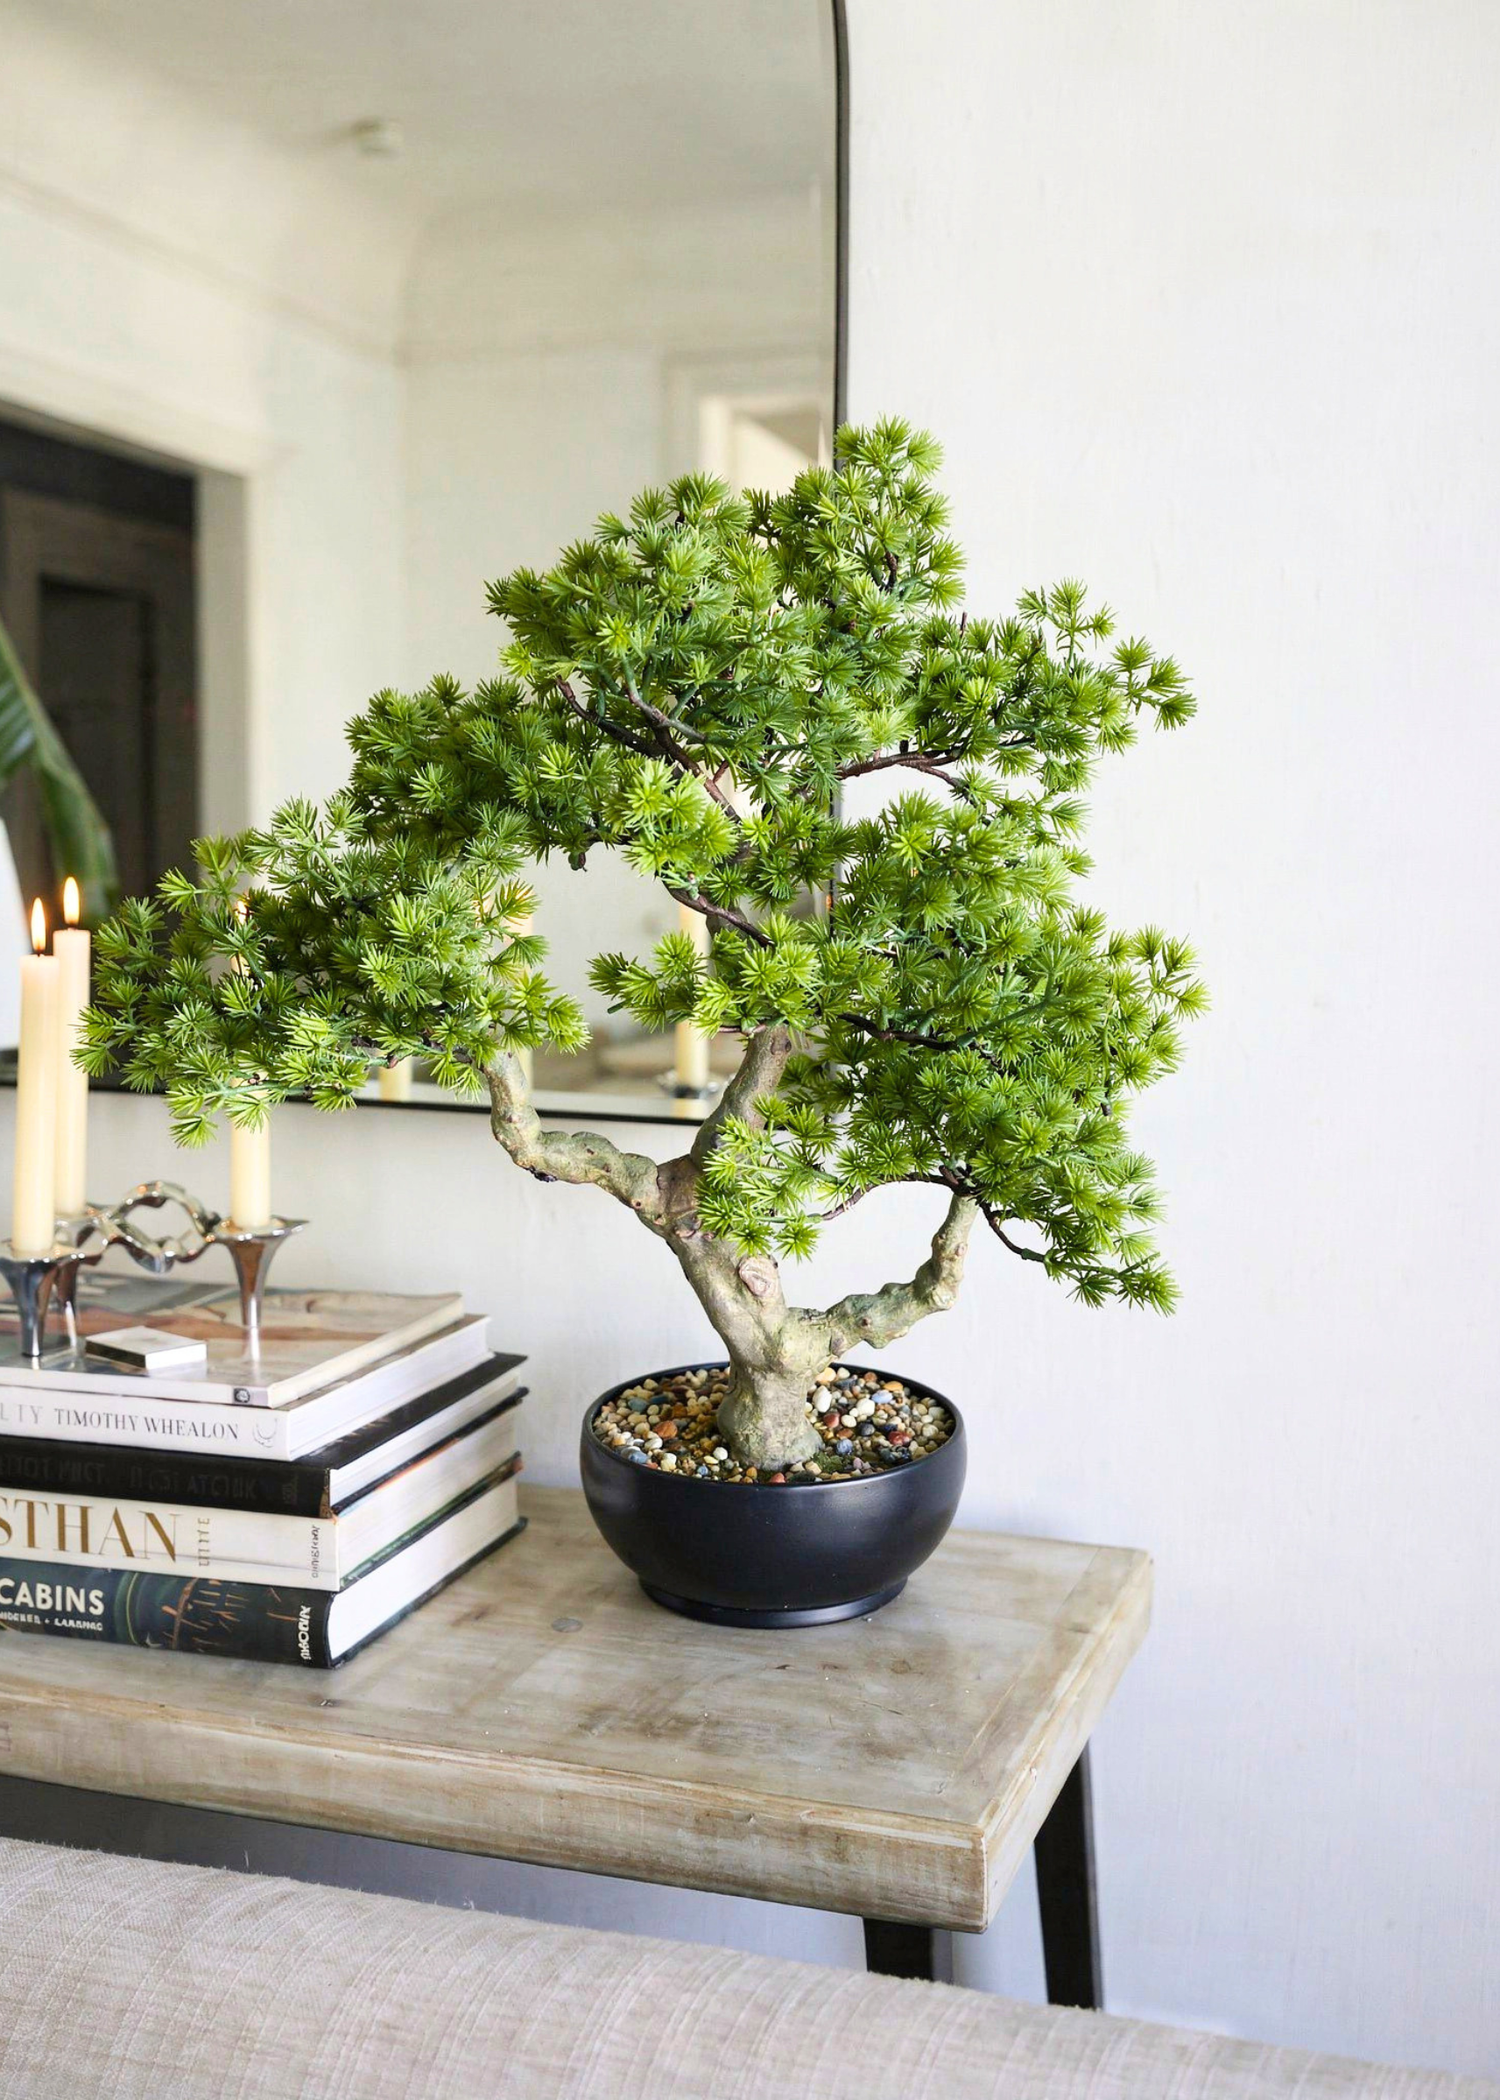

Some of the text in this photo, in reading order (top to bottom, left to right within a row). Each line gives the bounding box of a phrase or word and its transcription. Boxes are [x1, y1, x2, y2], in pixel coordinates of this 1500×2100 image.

[54, 1408, 140, 1433] TIMOTHY
[144, 1417, 239, 1440] WHEALON
[0, 1578, 105, 1616] CABINS
